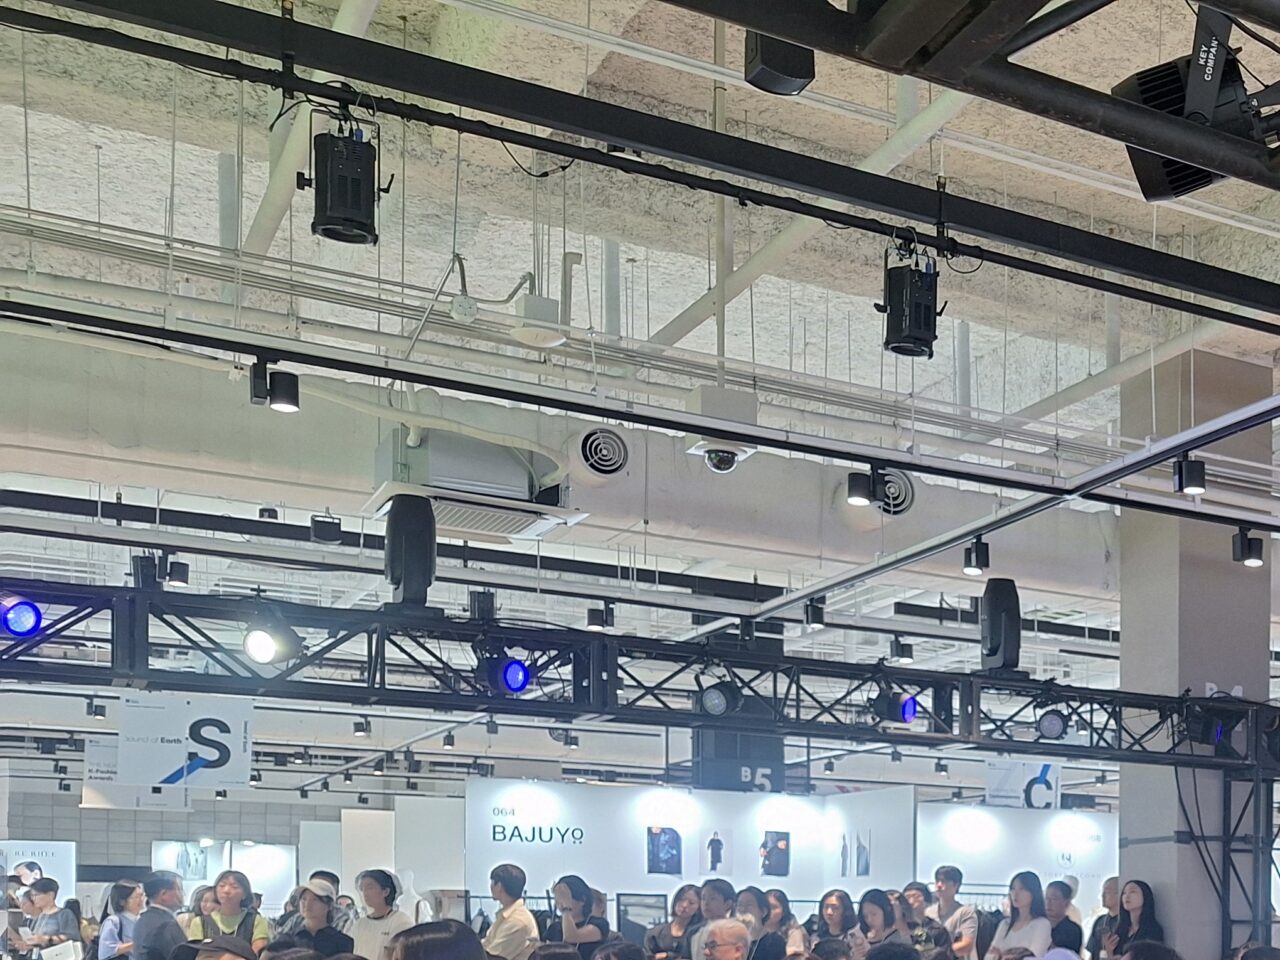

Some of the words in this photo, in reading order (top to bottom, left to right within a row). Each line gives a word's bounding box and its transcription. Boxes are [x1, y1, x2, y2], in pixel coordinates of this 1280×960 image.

[1198, 44, 1209, 66] KEY
[160, 736, 182, 745] Earth
[188, 717, 231, 769] S
[492, 808, 516, 817] 064
